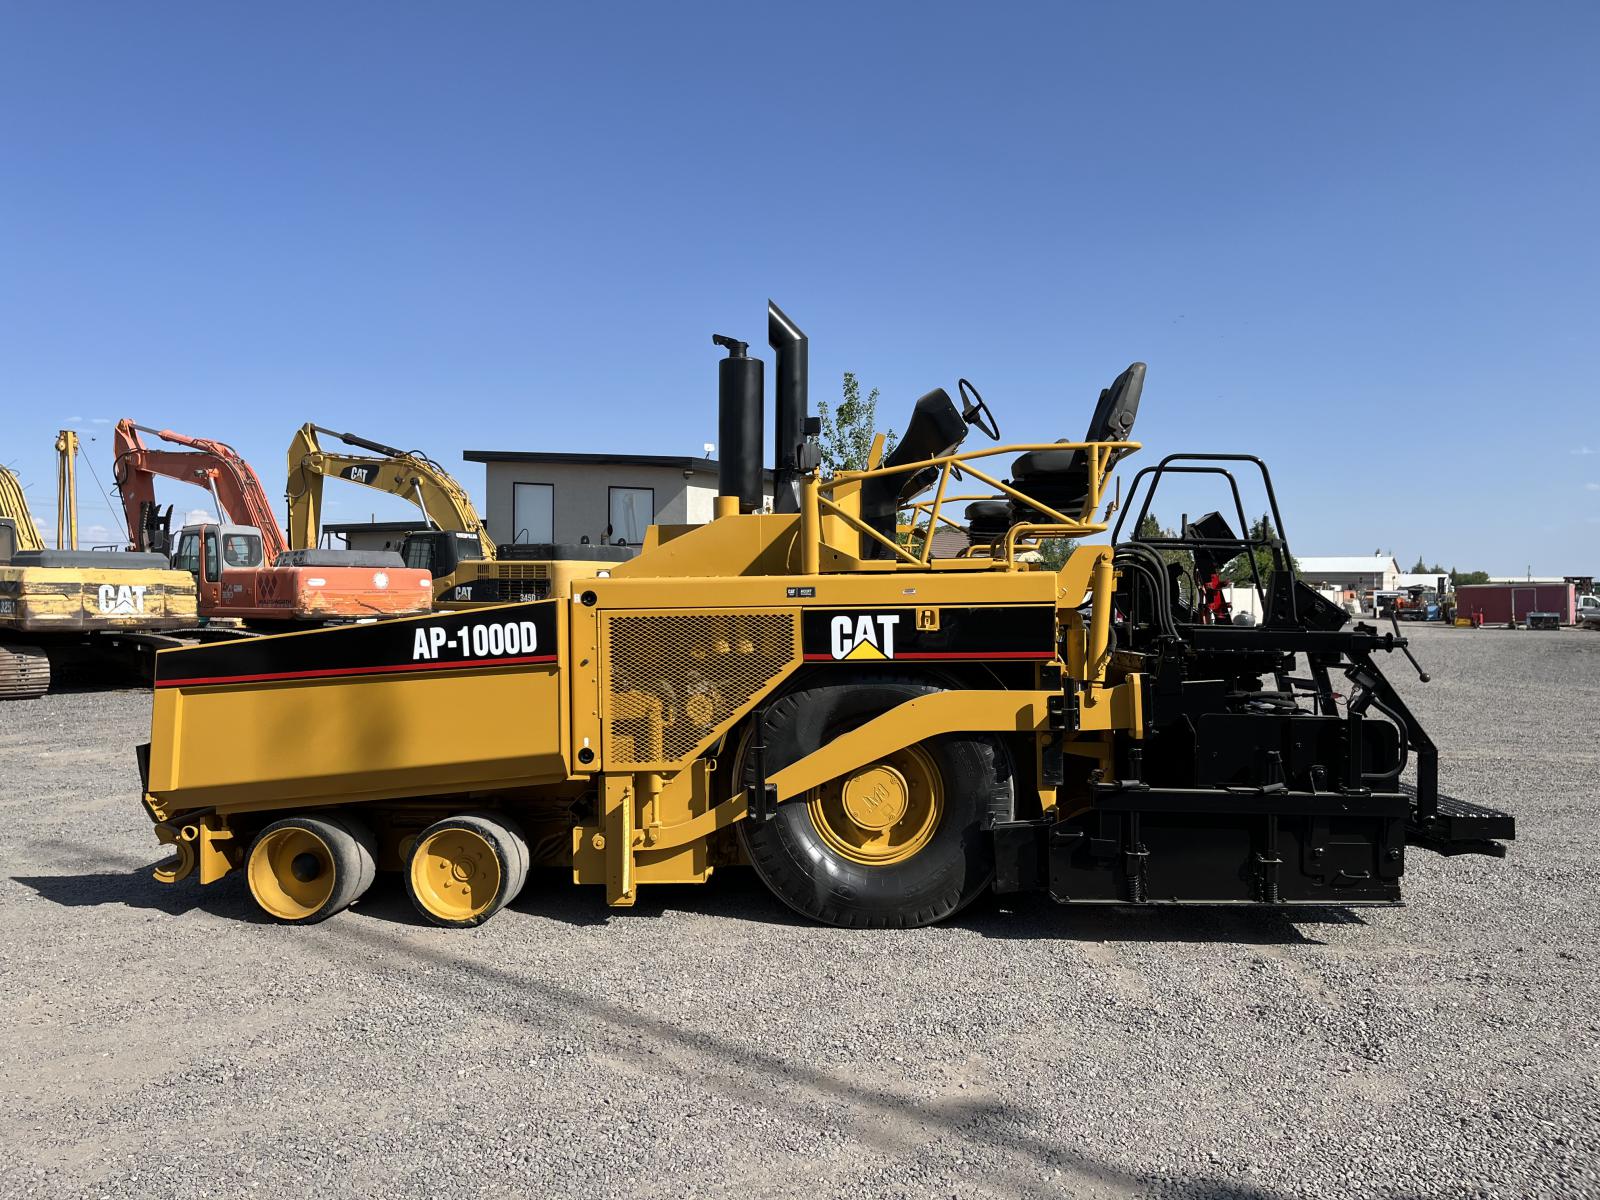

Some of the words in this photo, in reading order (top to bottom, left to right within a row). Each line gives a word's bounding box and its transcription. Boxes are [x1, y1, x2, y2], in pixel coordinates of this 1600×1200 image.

[350, 467, 368, 483] CAT
[98, 584, 147, 615] CAT
[455, 586, 473, 601] CAT
[412, 621, 538, 660] AP-1000D
[830, 614, 900, 660] CAT
